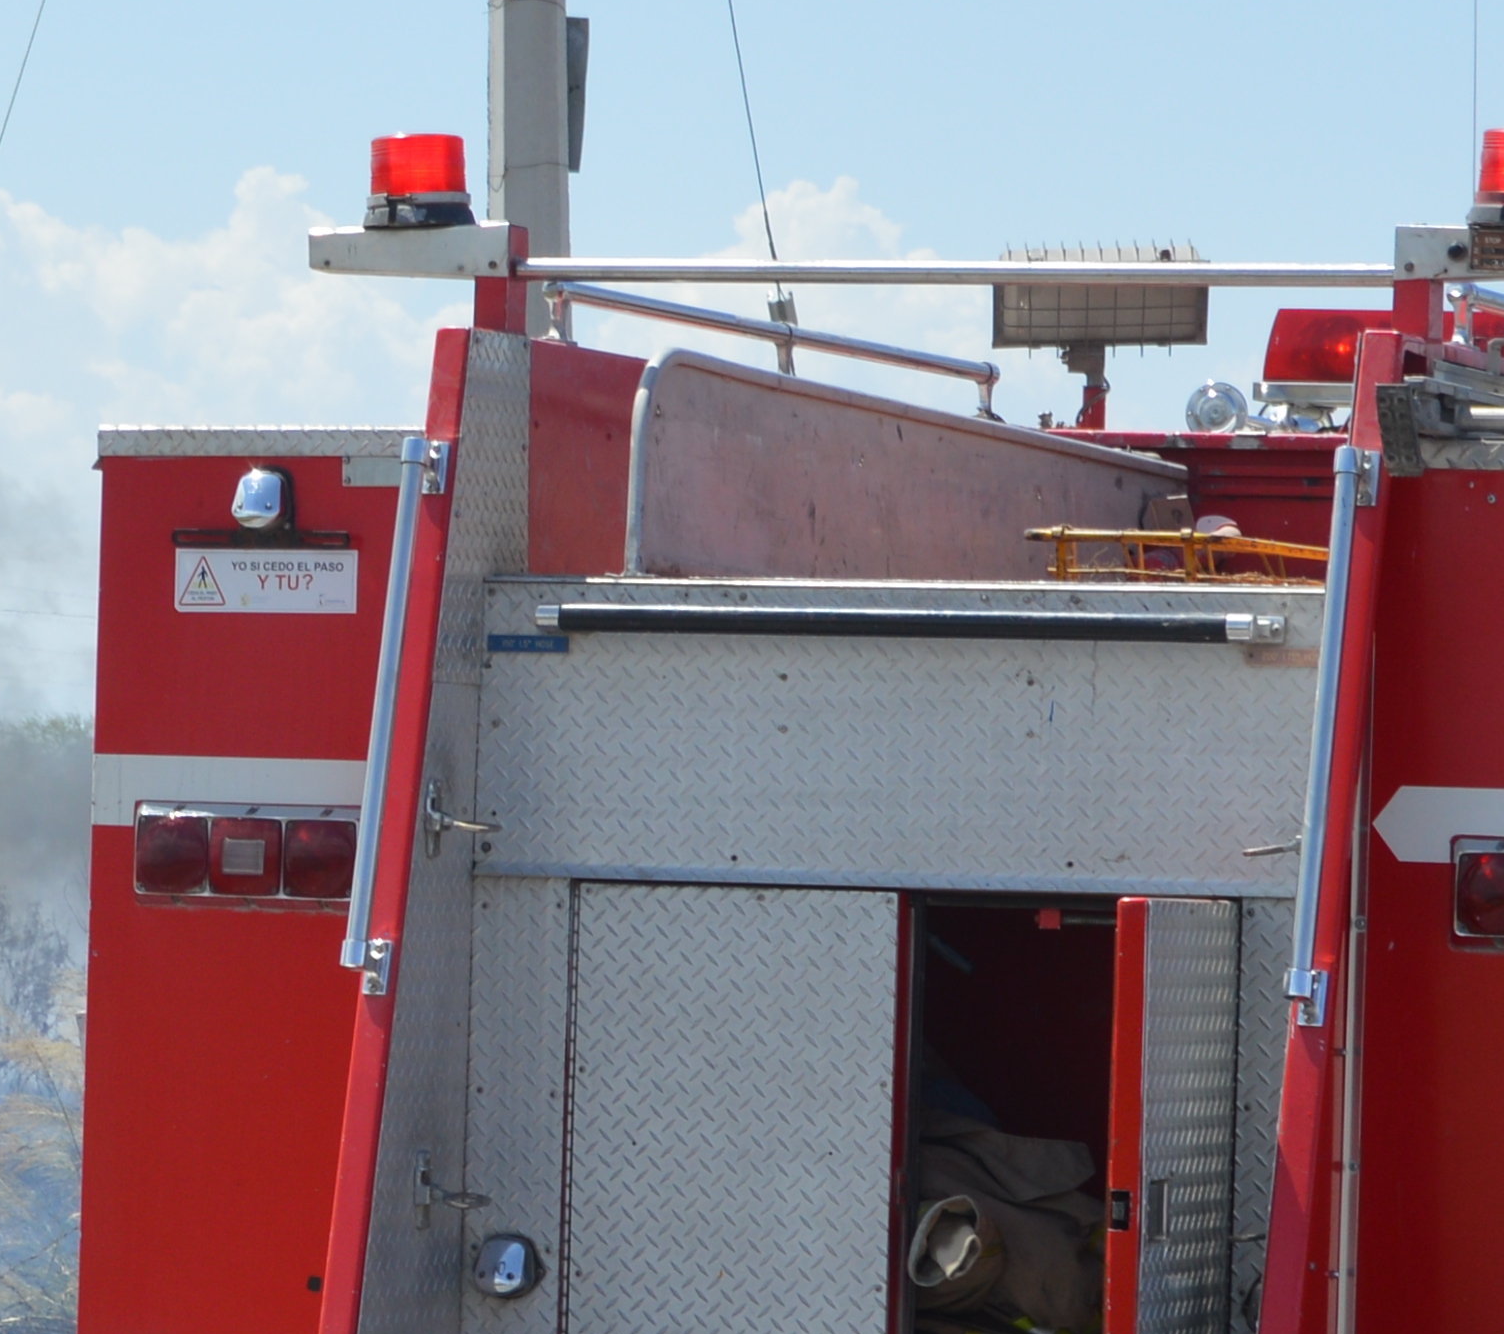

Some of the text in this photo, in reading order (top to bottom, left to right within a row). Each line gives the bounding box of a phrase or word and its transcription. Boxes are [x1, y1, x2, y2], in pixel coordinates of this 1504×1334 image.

[231, 561, 345, 572] YO SI CEDO EL PASO
[257, 574, 269, 590] Y
